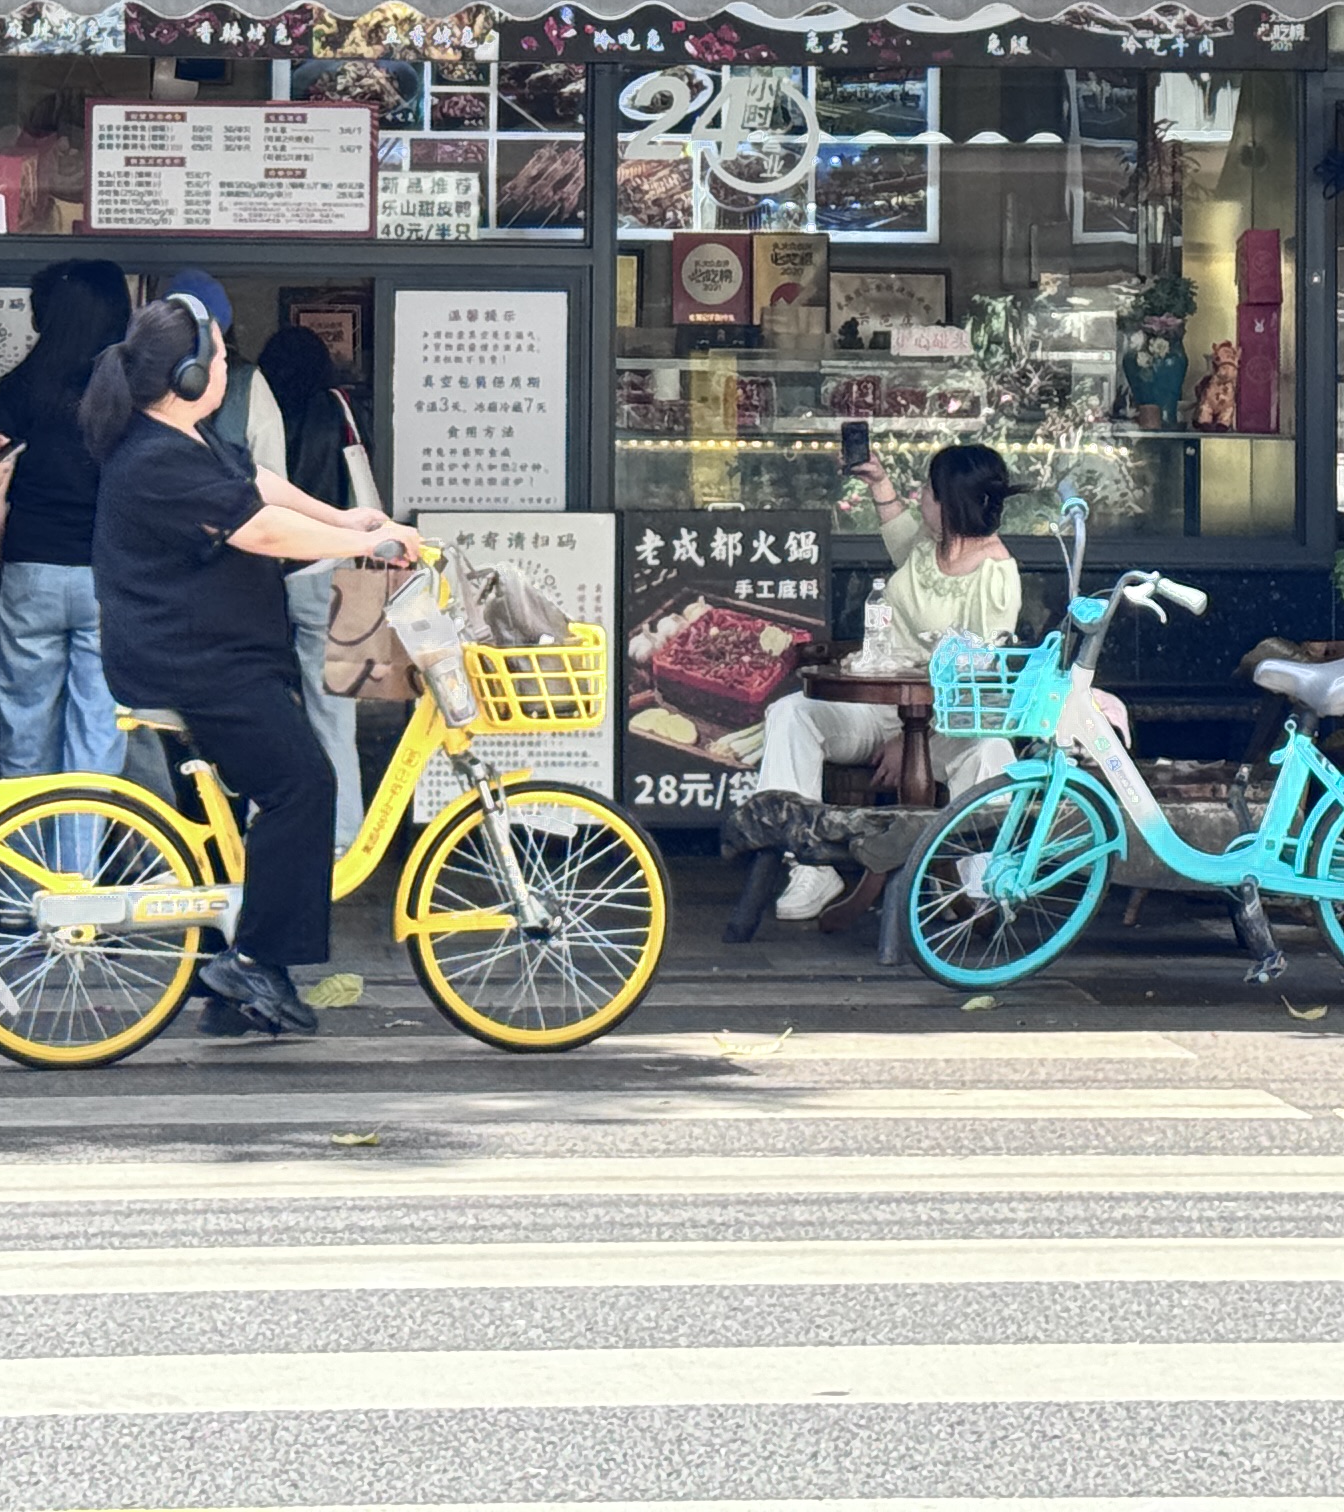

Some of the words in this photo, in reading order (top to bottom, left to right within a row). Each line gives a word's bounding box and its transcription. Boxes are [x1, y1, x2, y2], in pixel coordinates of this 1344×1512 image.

[381, 176, 472, 195] 新品推荐
[381, 199, 472, 217] 乐山甜皮鸭
[457, 530, 577, 550] 邮寄请扫码
[634, 526, 820, 568] 老成都火鍋
[733, 578, 820, 600] 手工底料
